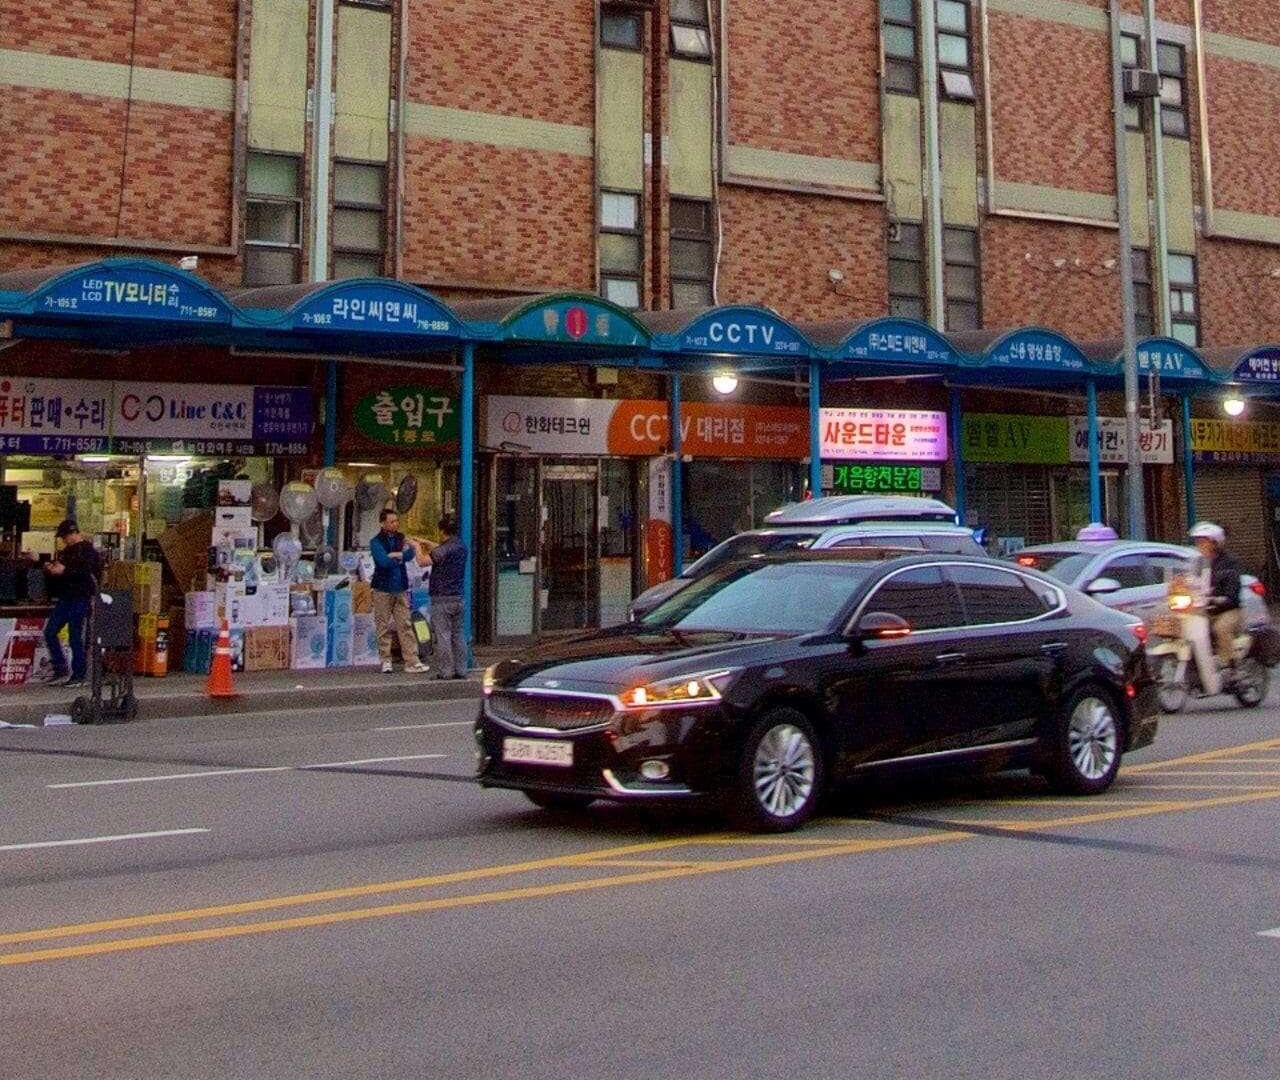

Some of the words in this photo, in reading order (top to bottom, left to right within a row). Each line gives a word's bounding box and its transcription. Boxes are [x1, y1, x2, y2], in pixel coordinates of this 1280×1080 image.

[81, 291, 103, 302] LCD
[82, 279, 104, 290] LED
[104, 280, 167, 306] TV모니터
[332, 297, 418, 324] 라인씨앤씨
[709, 321, 776, 345] CCTV
[170, 400, 206, 419] Line
[211, 401, 248, 420] C&C
[370, 390, 455, 428] 출입구
[524, 415, 591, 436] 한화테크윈
[696, 417, 746, 444] 대리점
[824, 421, 907, 447] 사운드타운
